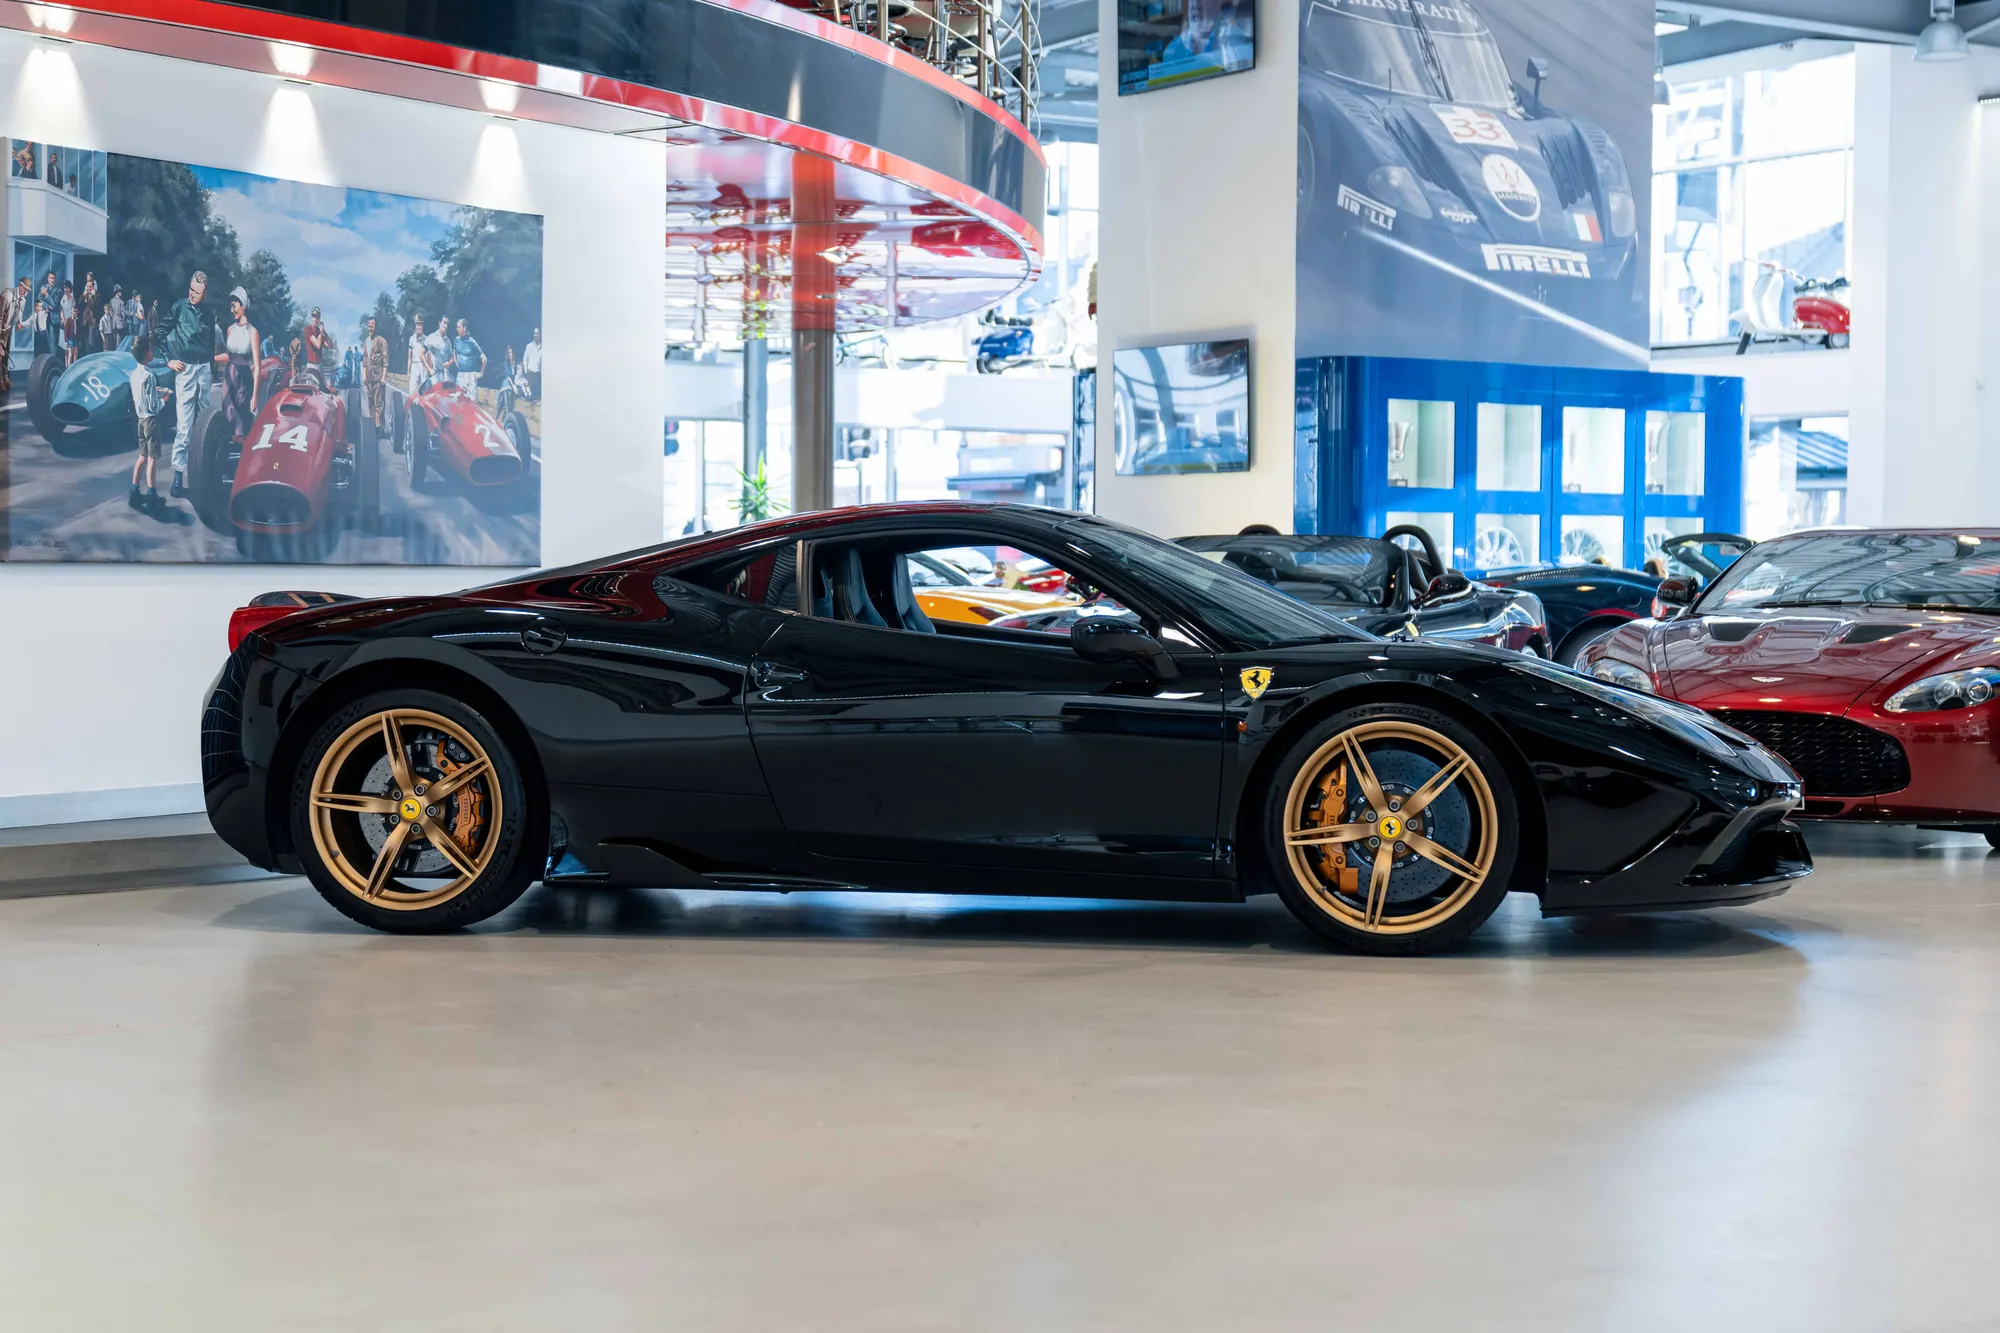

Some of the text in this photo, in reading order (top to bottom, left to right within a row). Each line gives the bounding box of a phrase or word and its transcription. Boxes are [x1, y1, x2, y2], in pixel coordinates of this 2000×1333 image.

[1452, 118, 1501, 140] 33
[1497, 191, 1536, 204] MASERATI
[1481, 243, 1591, 278] PIRELLI
[81, 376, 110, 400] 18
[252, 423, 309, 453] 14
[1382, 707, 1430, 718] MICHELIN
